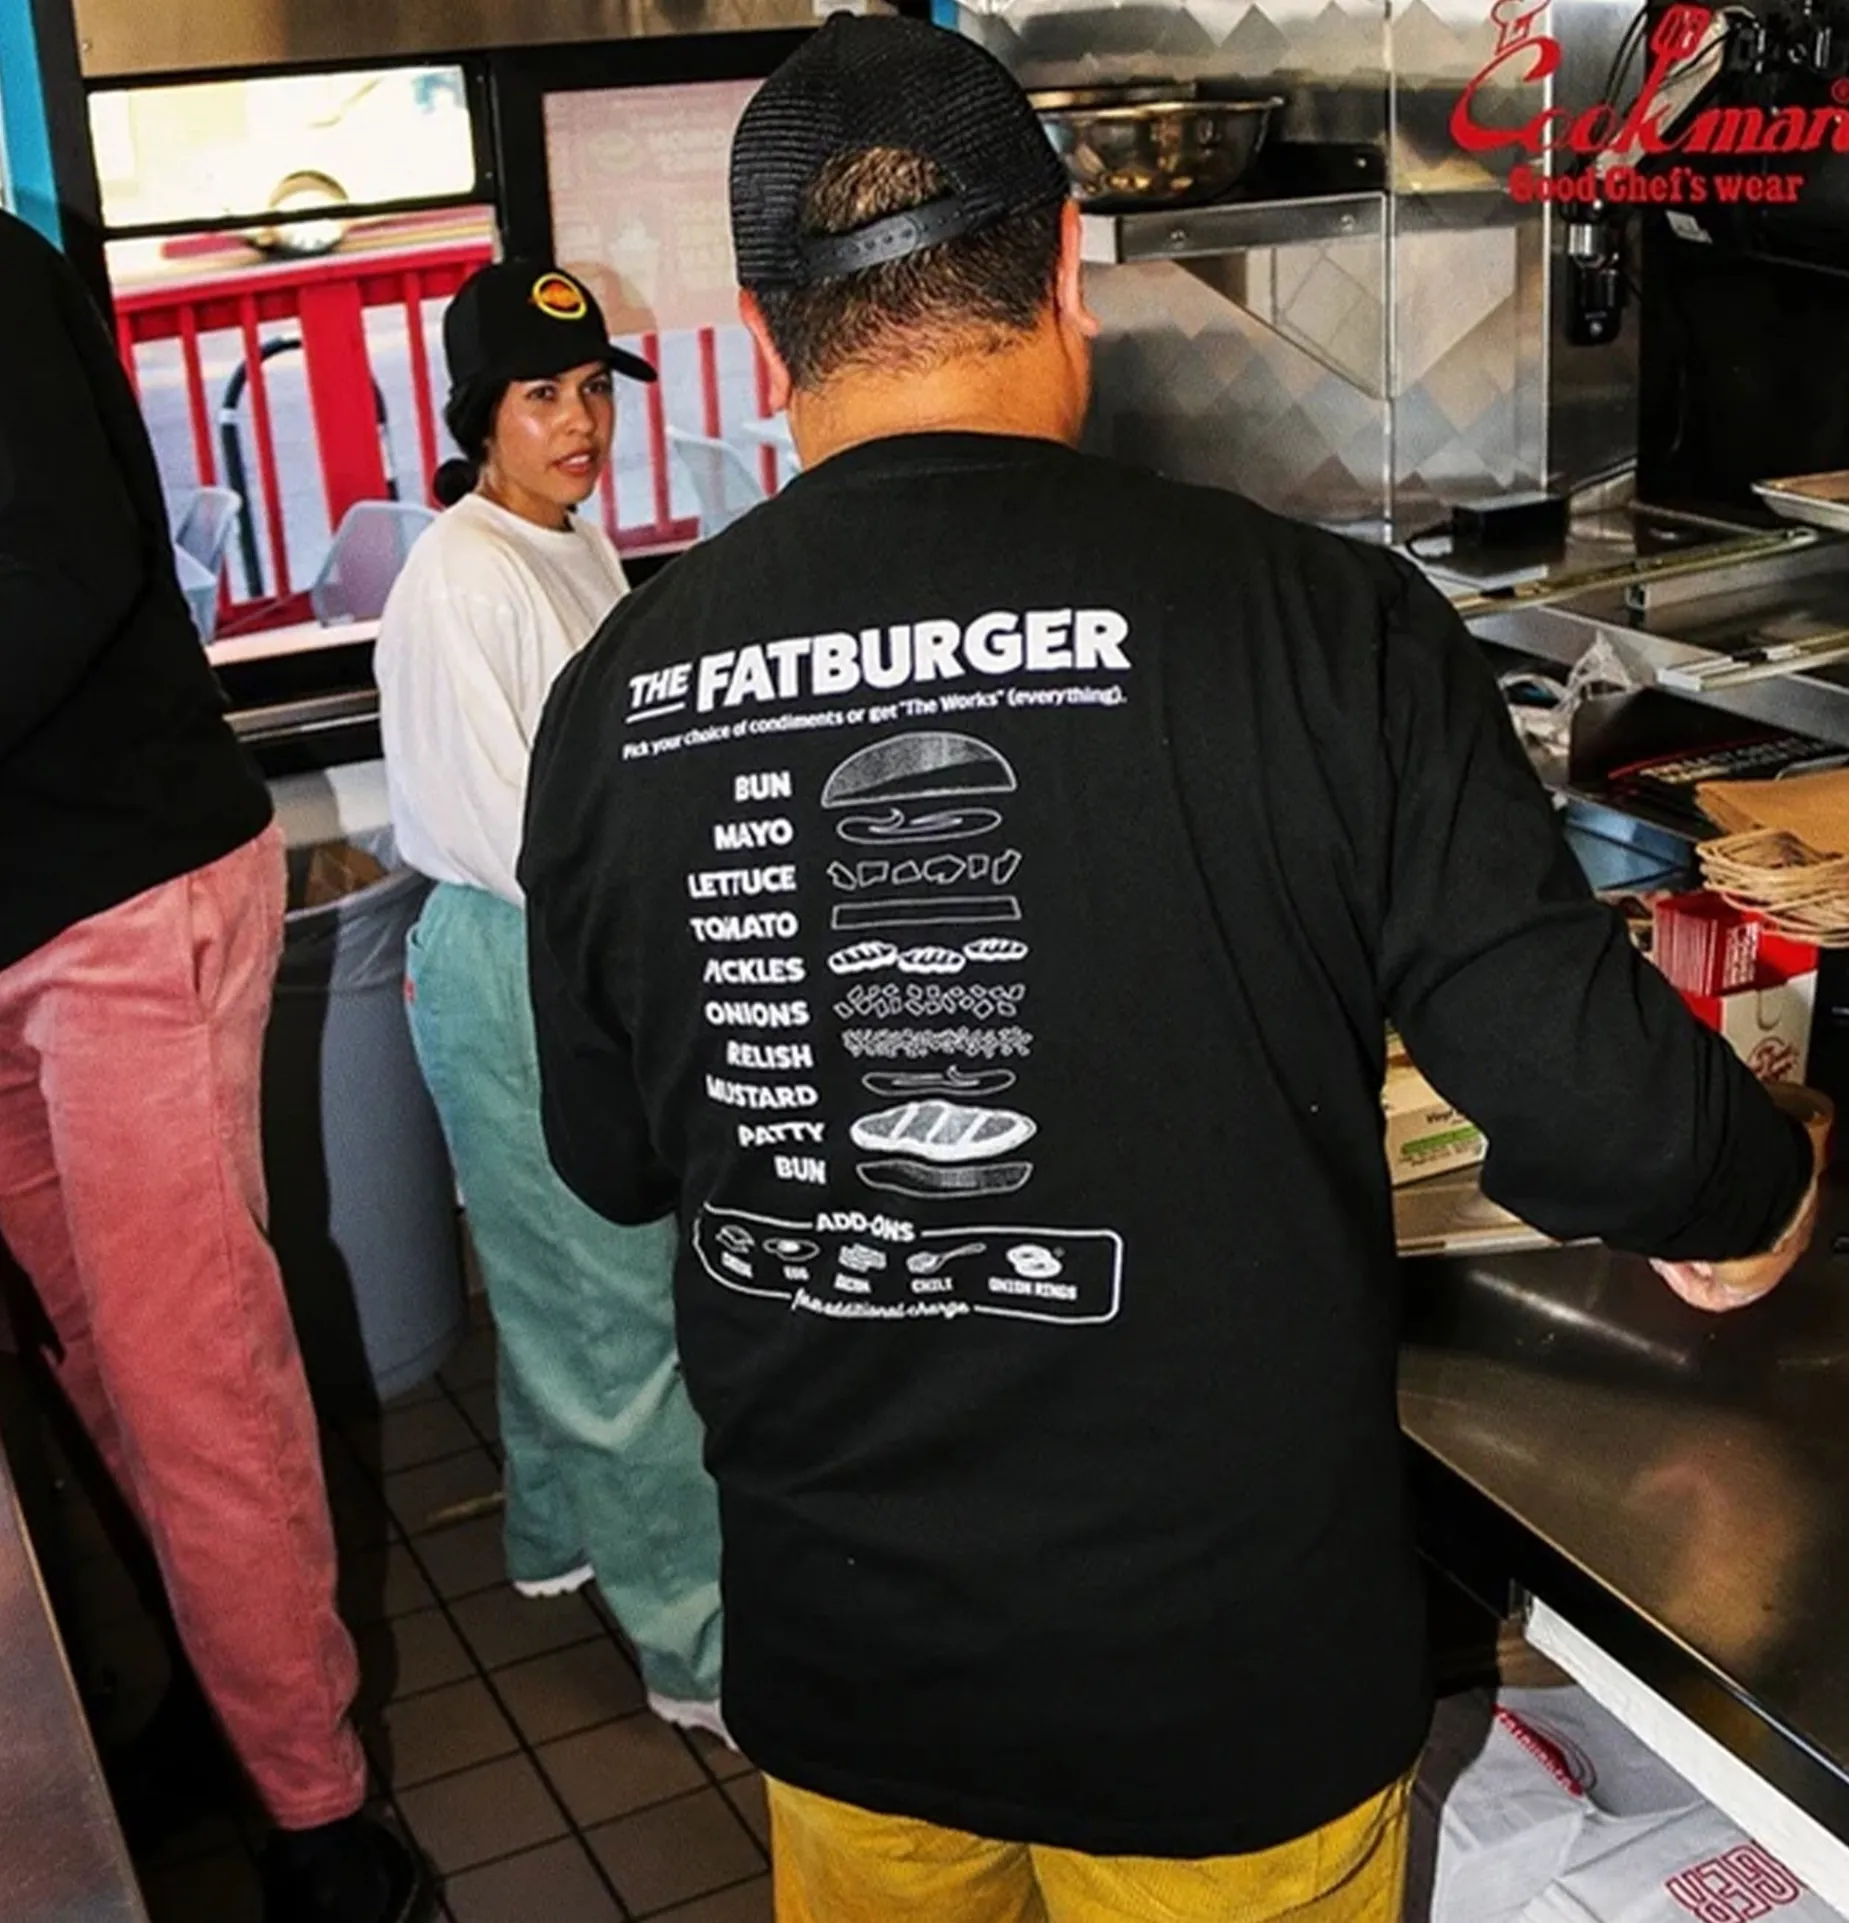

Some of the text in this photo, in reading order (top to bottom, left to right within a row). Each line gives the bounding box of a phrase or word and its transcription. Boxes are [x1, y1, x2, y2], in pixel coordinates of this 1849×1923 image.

[629, 608, 1132, 713] THE FATBURGER
[651, 733, 684, 755] your
[683, 723, 731, 746] choice
[732, 719, 748, 738] of
[749, 710, 844, 733] condiments
[846, 708, 866, 725] or
[868, 705, 898, 725] get
[734, 770, 792, 802] BUN
[713, 817, 794, 851] MAYO
[687, 864, 797, 899] LETTUCE
[689, 911, 799, 942] TOMATO
[704, 1000, 811, 1028] ONIONS
[726, 1038, 815, 1070] RELISH
[705, 1072, 820, 1110] MUSTARD
[737, 1121, 826, 1148] PATTY
[773, 1153, 827, 1185] BUN
[816, 1210, 916, 1243] ADD-ONS
